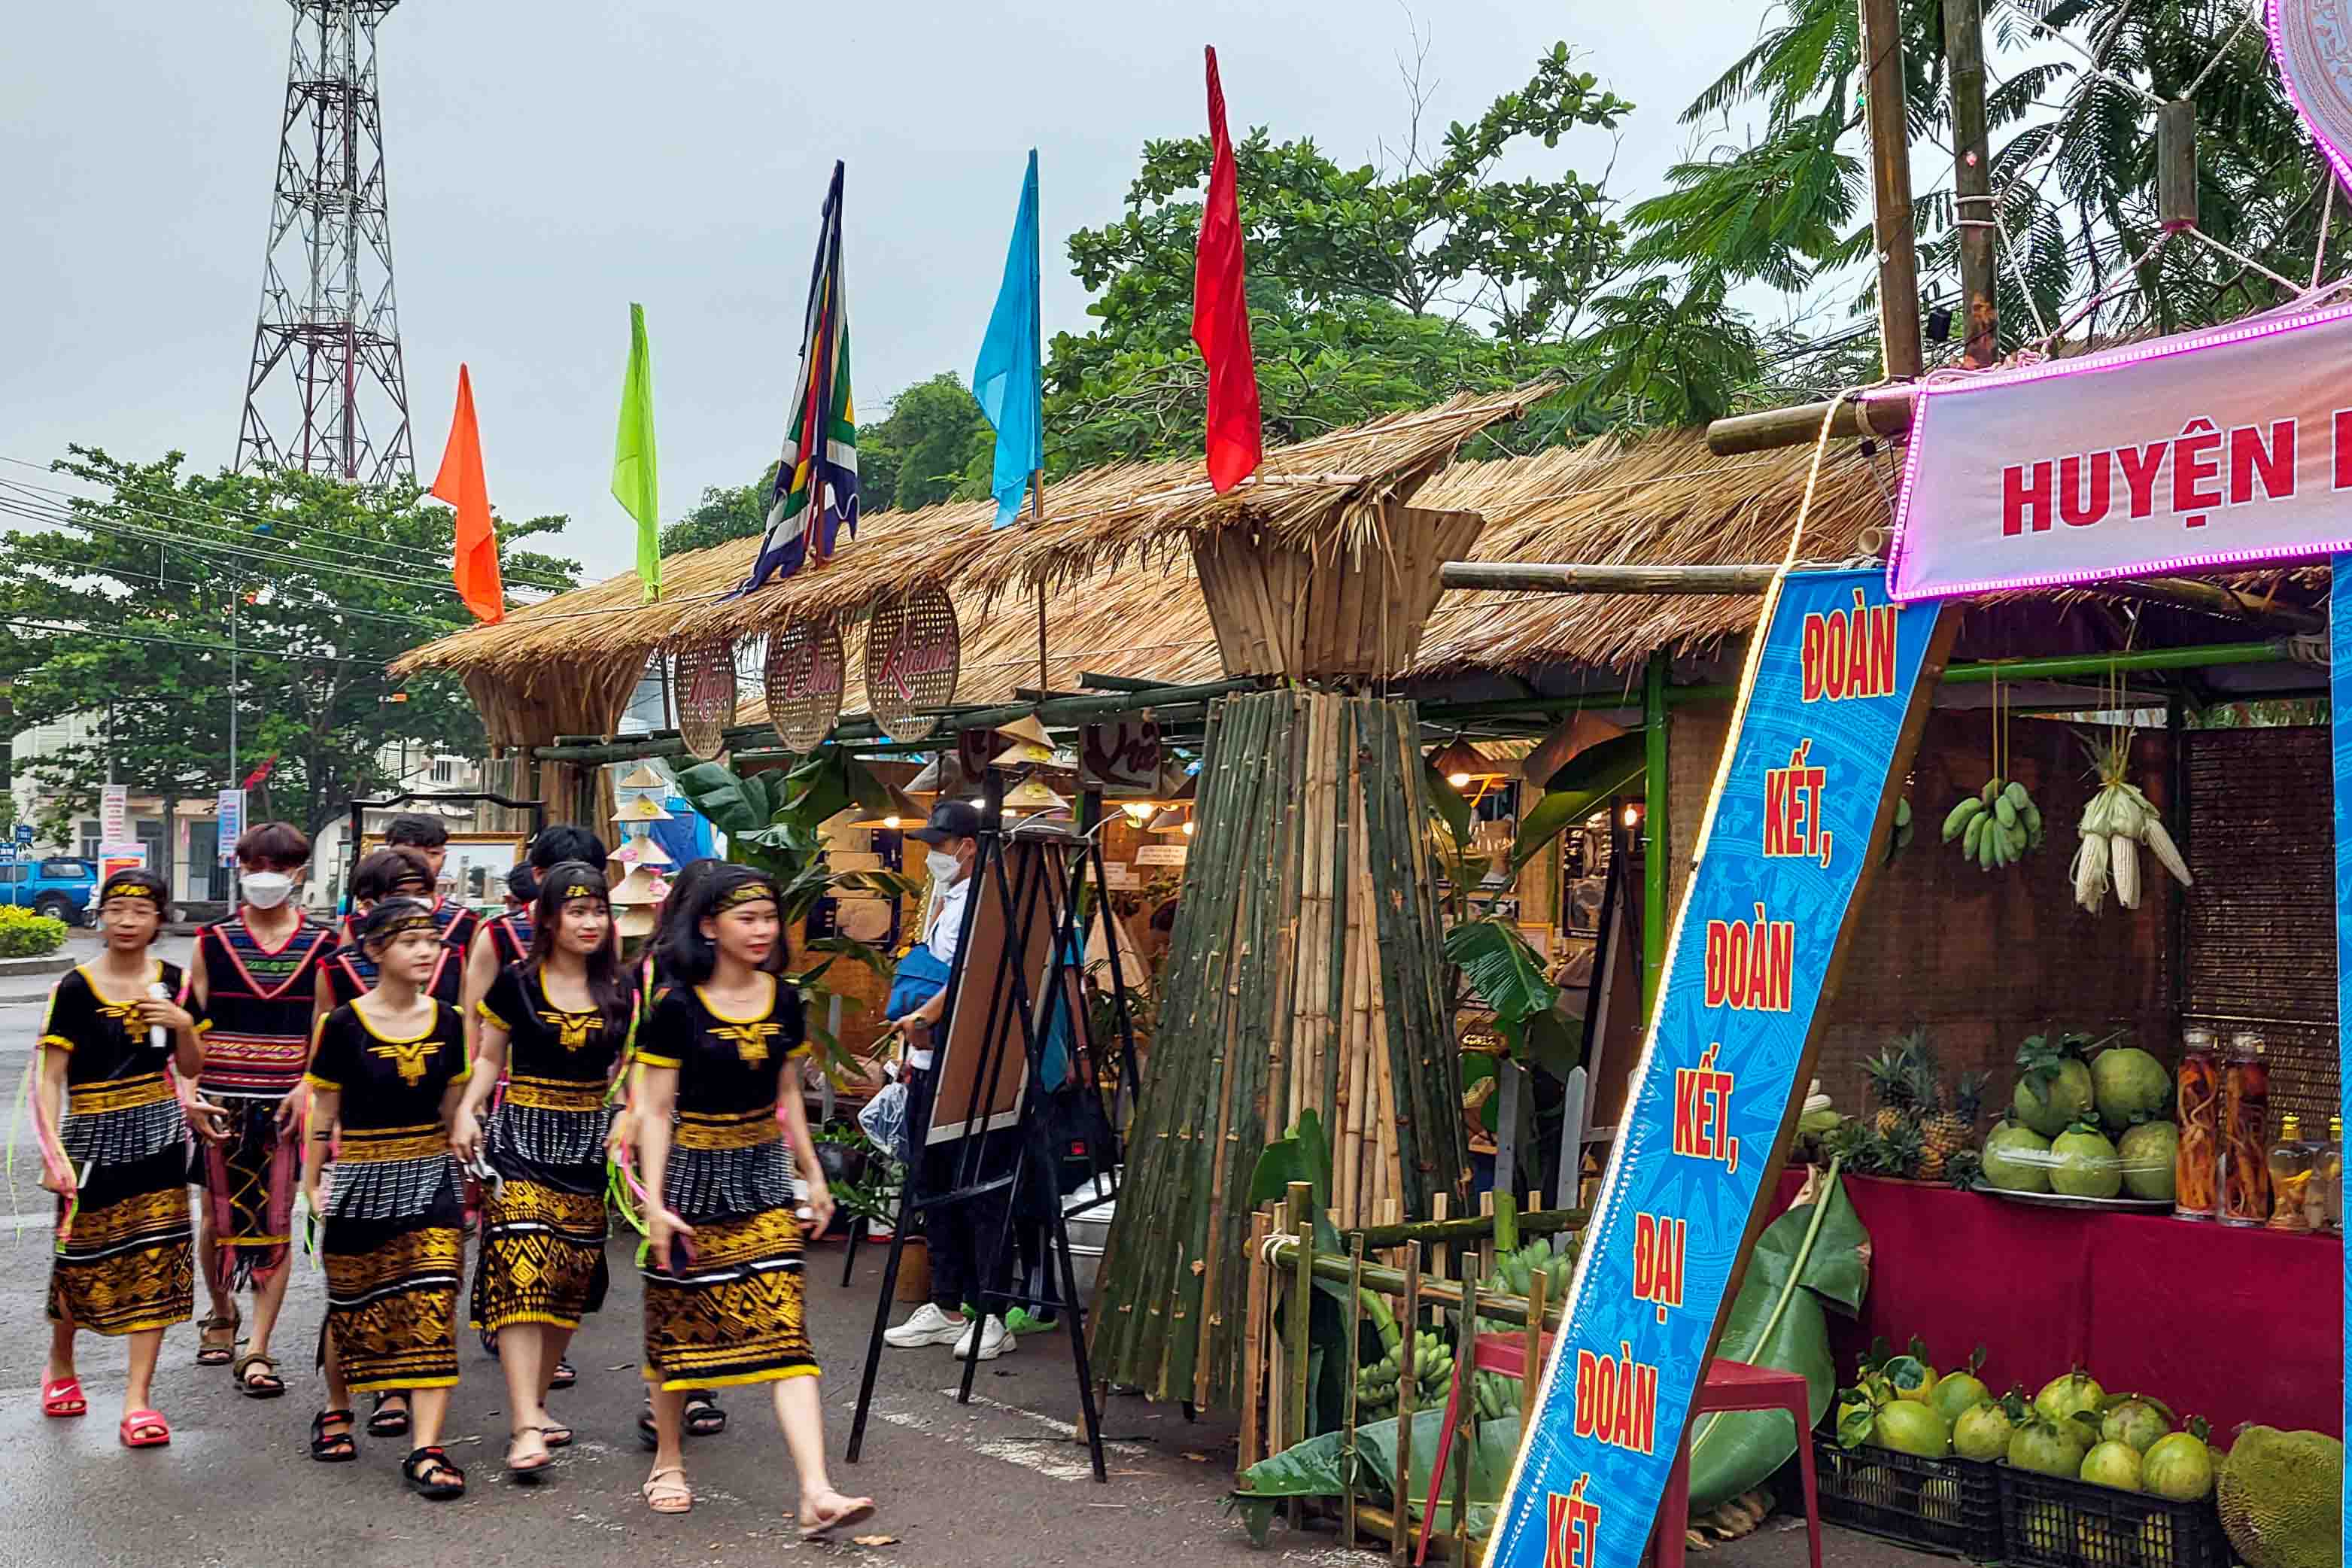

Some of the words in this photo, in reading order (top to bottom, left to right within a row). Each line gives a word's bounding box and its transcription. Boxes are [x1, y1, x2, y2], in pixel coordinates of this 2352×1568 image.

[2001, 415, 2298, 539] HUYỆN
[1801, 588, 1898, 703] ĐOÀN
[1764, 738, 1832, 869] KẾT,
[1705, 902, 1794, 1012] ĐOÀN
[1673, 1043, 1739, 1174] KẾT,
[1633, 1212, 1686, 1324] ĐẠI
[1574, 1341, 1658, 1455] ĐOÀN
[1543, 1472, 1600, 1568] KẾT
